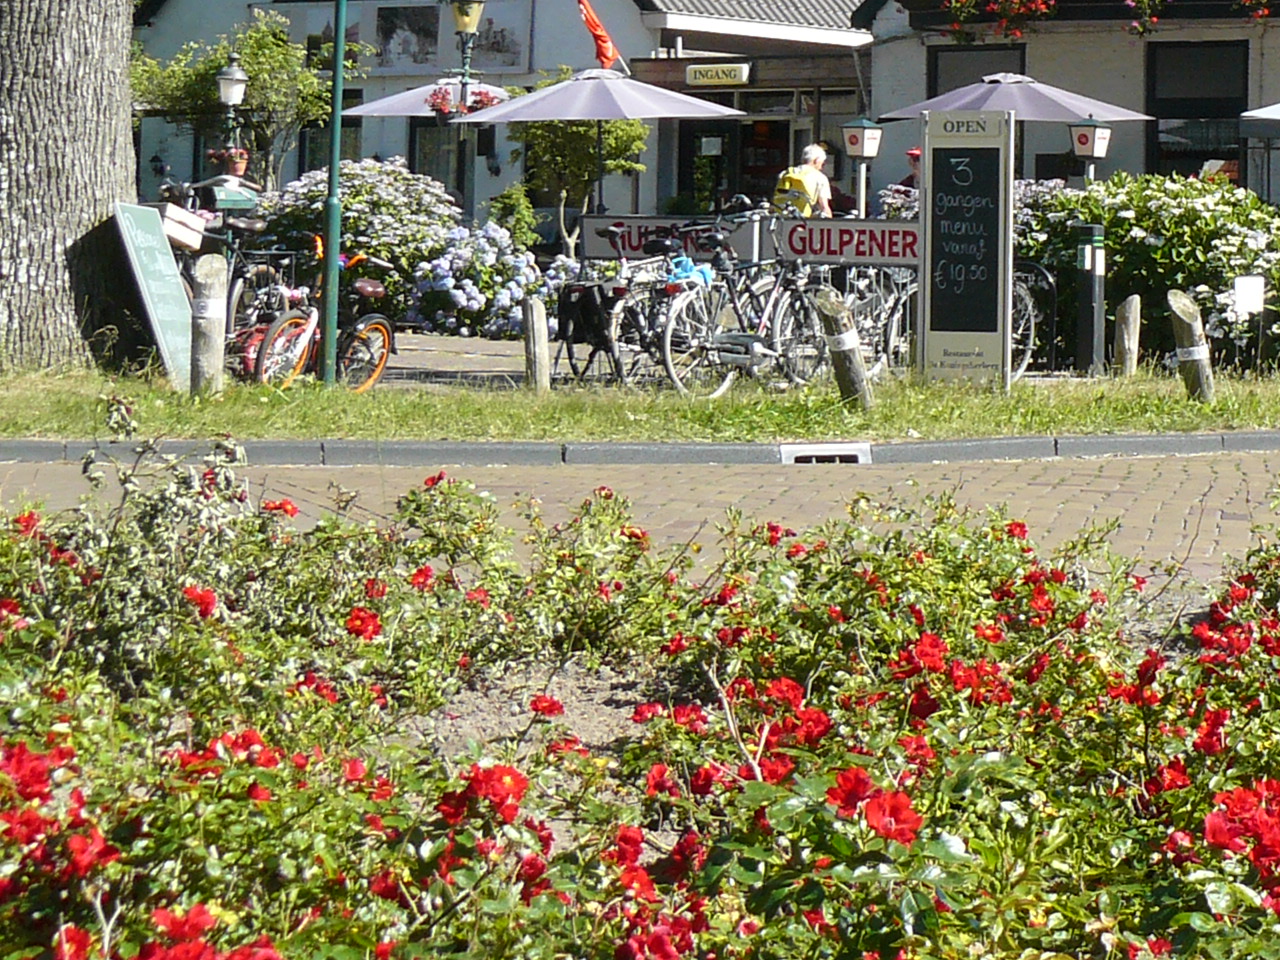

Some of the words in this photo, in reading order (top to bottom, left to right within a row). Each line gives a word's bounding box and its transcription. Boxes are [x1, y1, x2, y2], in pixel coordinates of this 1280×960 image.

[693, 68, 738, 81] INGANG
[943, 120, 987, 134] OPEN
[949, 157, 973, 186] 3
[936, 192, 995, 217] gangen
[940, 219, 989, 236] menu
[788, 223, 919, 258] GULPENER
[942, 239, 988, 260] vanaf
